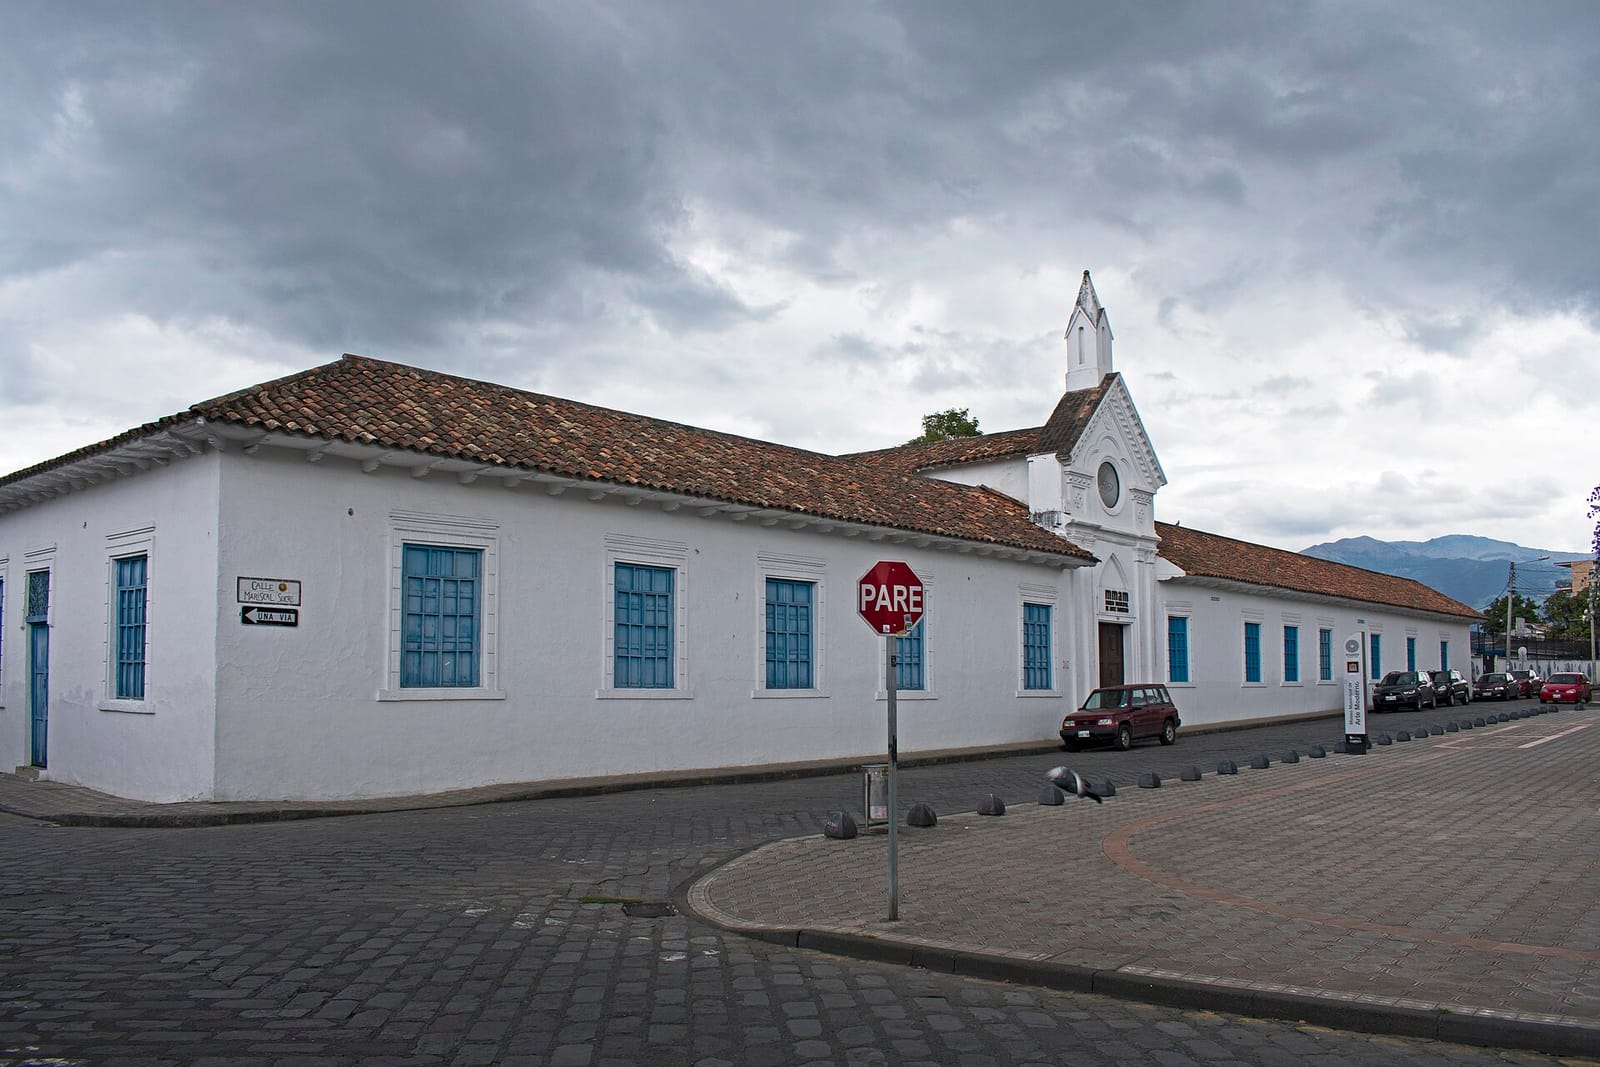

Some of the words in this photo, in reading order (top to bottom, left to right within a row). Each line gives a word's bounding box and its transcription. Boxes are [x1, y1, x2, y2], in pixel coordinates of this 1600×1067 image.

[861, 584, 922, 612] PARE
[257, 612, 274, 621] UNA
[280, 613, 293, 621] VIA
